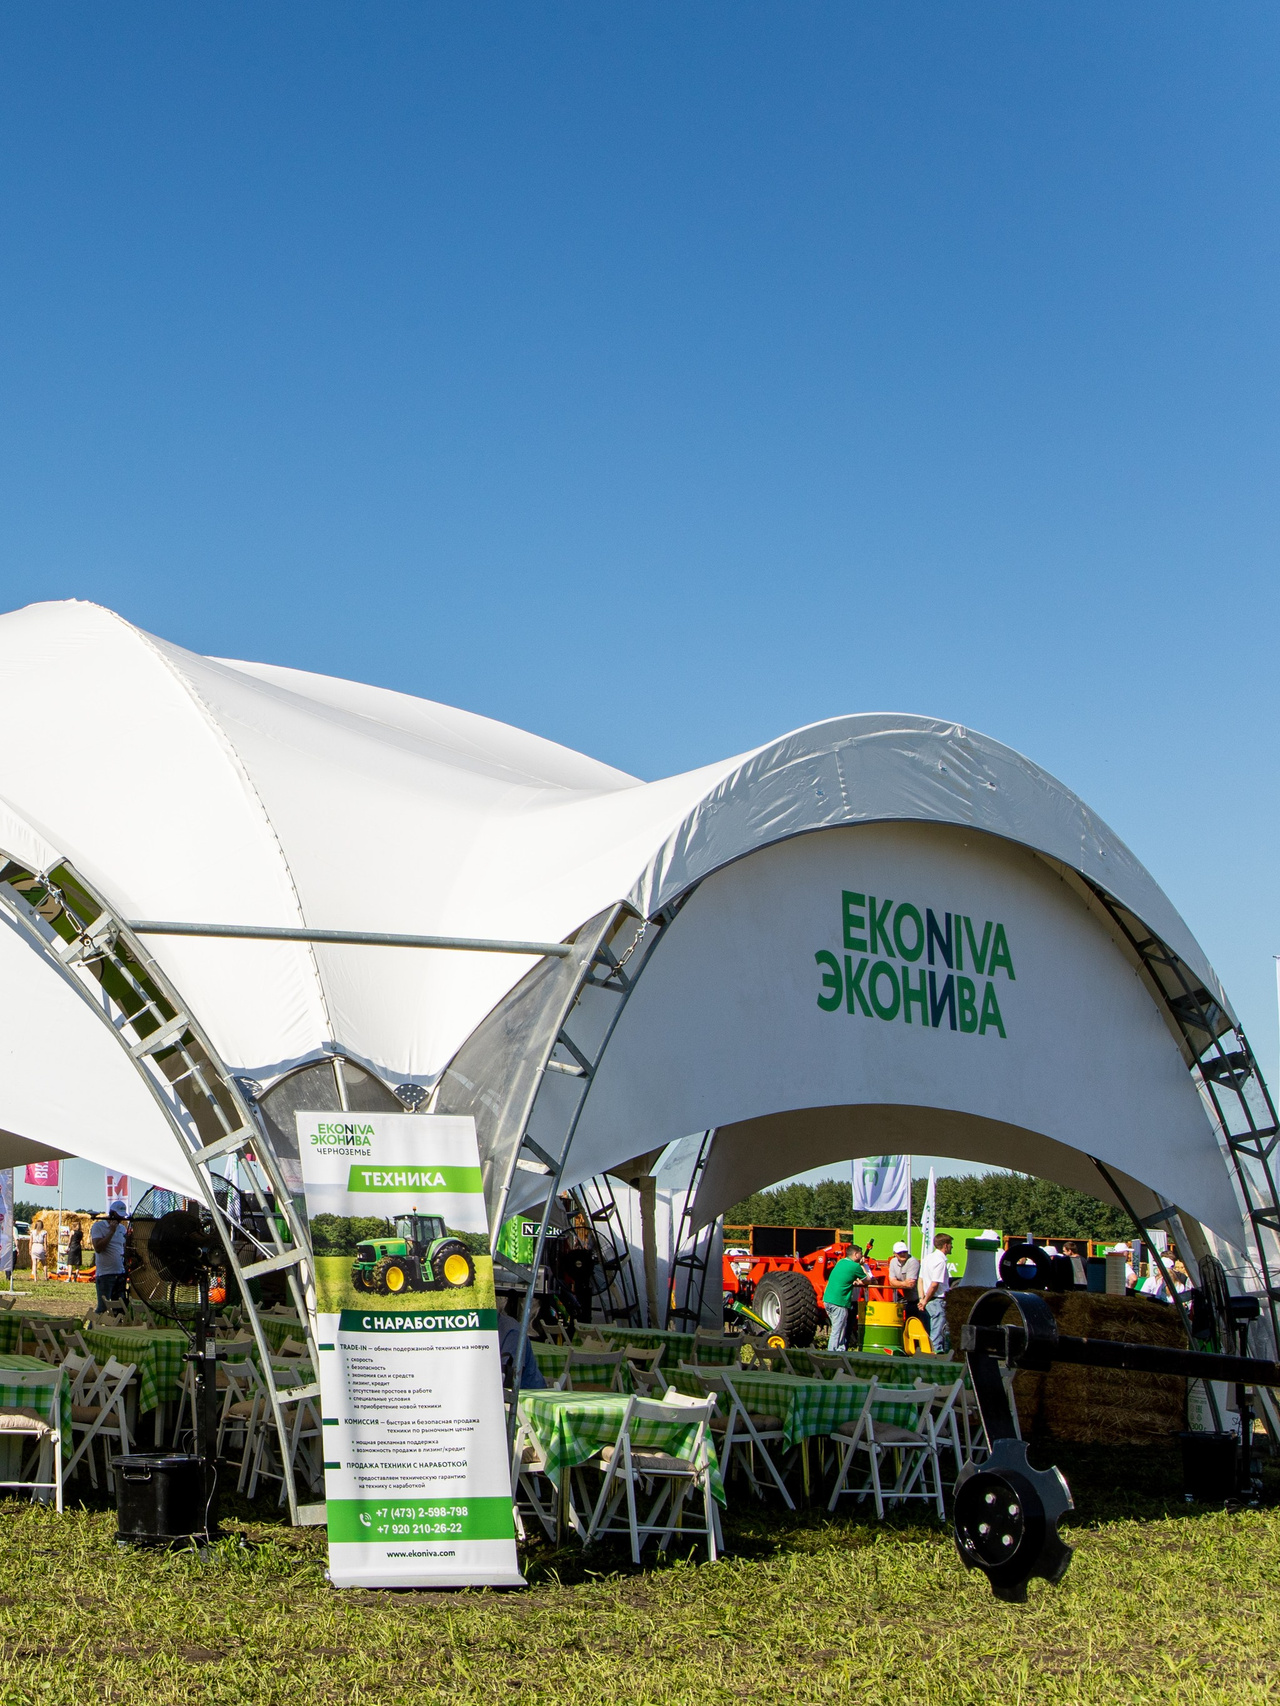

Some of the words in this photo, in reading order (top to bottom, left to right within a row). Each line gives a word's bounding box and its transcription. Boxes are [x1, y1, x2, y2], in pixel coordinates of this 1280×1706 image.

[842, 890, 1016, 980] EKONIVA
[814, 949, 1007, 1039] ЭКОНИВА
[317, 1123, 375, 1135] EKONIVA
[310, 1134, 371, 1146] ЭКОНИВА
[316, 1148, 371, 1156] ЧЕРНОЗЕМЬЕ
[361, 1171, 447, 1187] ТЕХНИКА
[362, 1317, 372, 1330] С
[374, 1312, 480, 1330] НАРАБОТКОЙ
[419, 1460, 467, 1468] НАРАБОТКОЙ
[375, 1508, 388, 1518] +7
[390, 1507, 416, 1520] (473)
[418, 1506, 468, 1518] 2-598-798
[377, 1524, 389, 1534] +7
[392, 1524, 410, 1534] 920
[412, 1523, 462, 1534] 210-26-22
[386, 1549, 456, 1558] www.ekoniva.com
